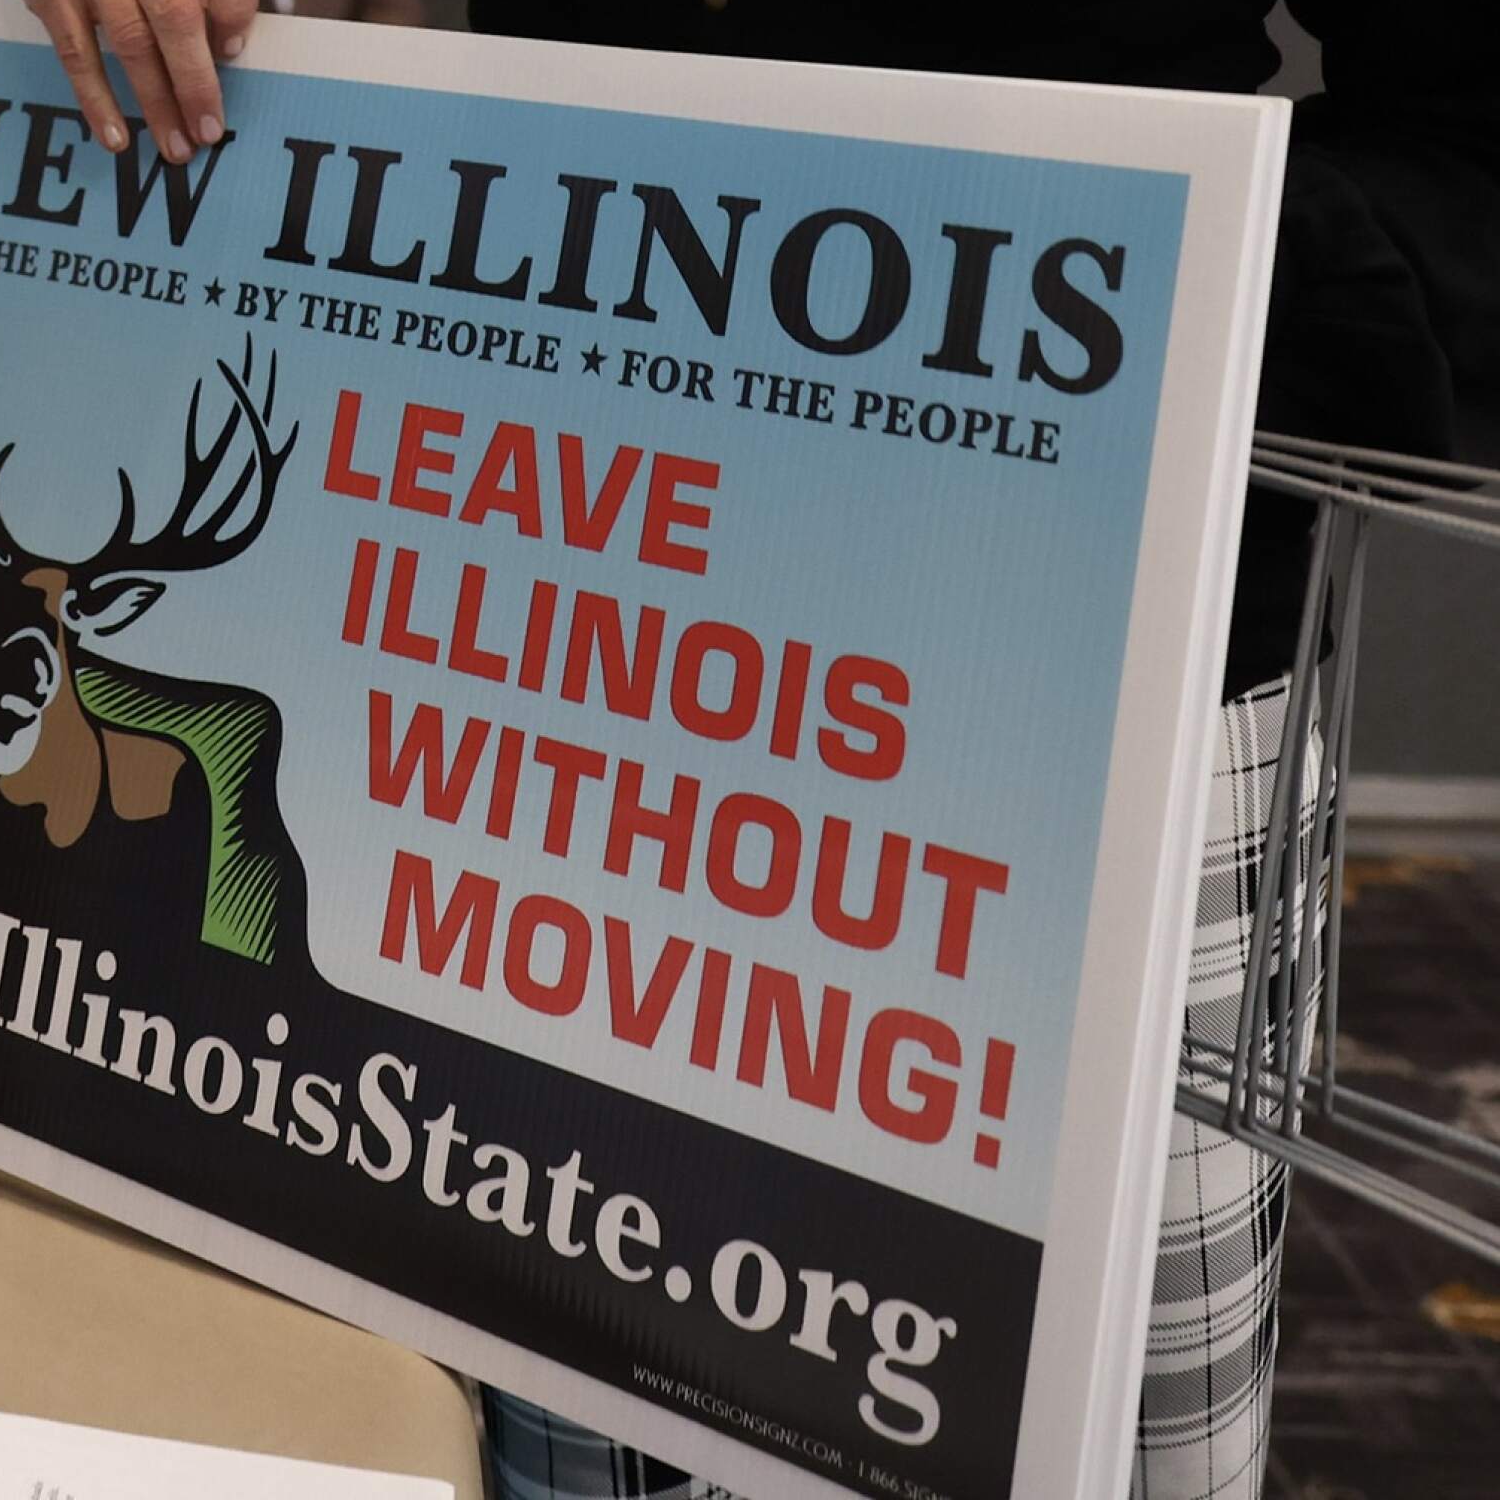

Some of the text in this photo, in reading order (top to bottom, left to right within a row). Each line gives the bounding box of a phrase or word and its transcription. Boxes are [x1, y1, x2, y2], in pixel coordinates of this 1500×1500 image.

[47, 249, 188, 307] PEOPLE
[233, 282, 289, 323] BY
[298, 292, 382, 341] THE
[391, 309, 562, 374] PEOPLE
[617, 348, 715, 403] FOR
[733, 368, 836, 424] THE
[849, 389, 1061, 465] PEOPLE
[262, 137, 1127, 396] ILLINOIS
[323, 390, 721, 575] LEAVE
[341, 538, 910, 781] ILLINOIS
[368, 689, 1010, 978] WITHOUT
[379, 850, 1015, 1168] MOVING!
[631, 1362, 844, 1470] WWW.PRECISIONSIGNZ.COM
